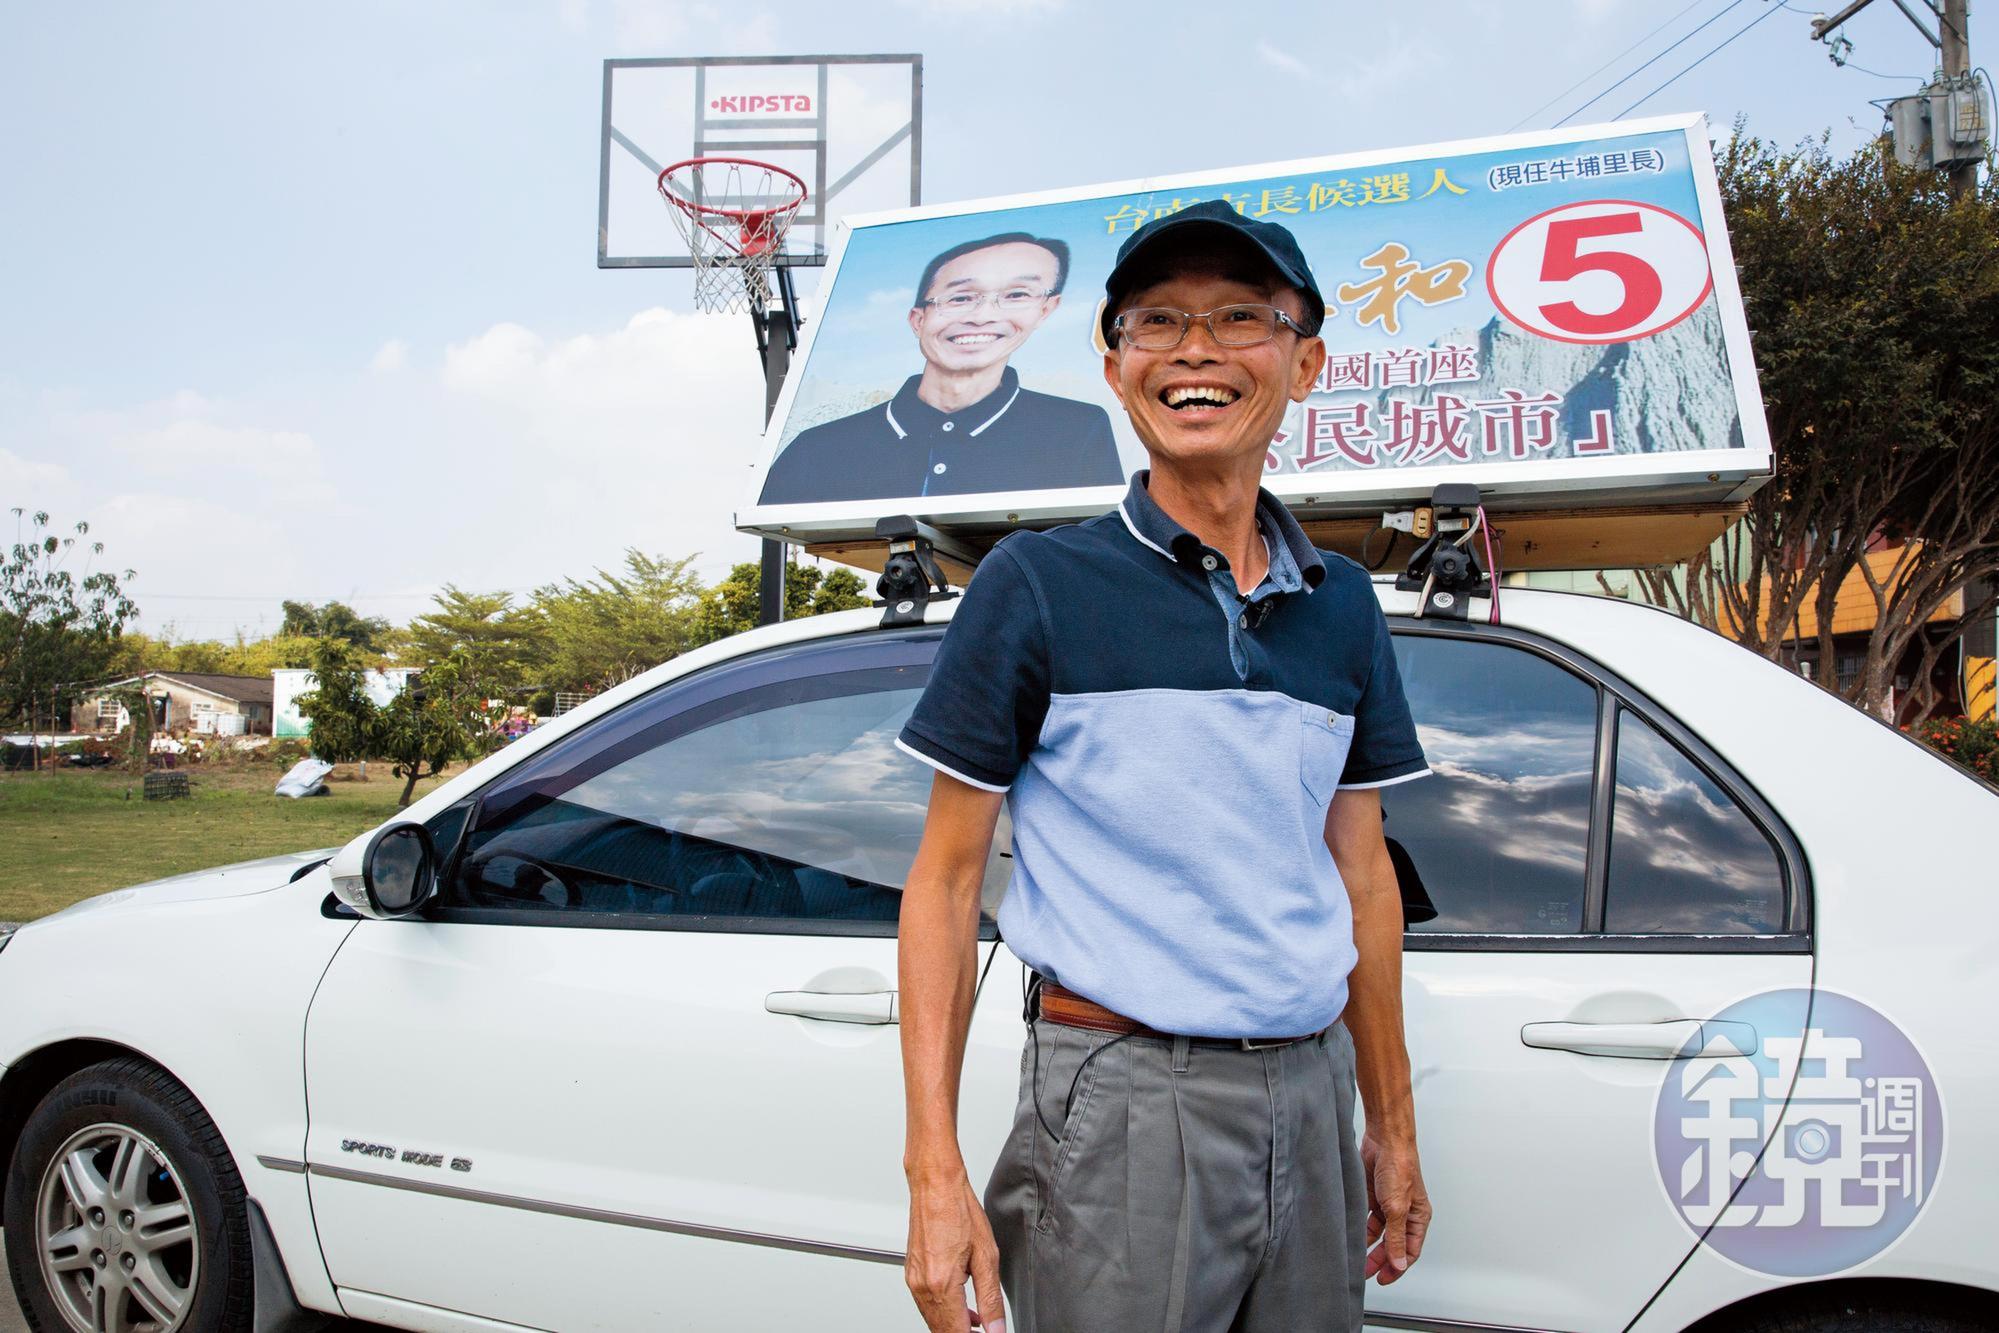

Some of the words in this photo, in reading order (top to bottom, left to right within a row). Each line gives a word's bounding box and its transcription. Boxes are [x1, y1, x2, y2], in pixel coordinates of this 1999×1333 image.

[1489, 149, 1665, 190] (現任牛埔里長)
[1538, 211, 1663, 335] 5
[1313, 345, 1477, 391] 國首座
[341, 1138, 396, 1160] SPORTS
[401, 1150, 443, 1168] MODE
